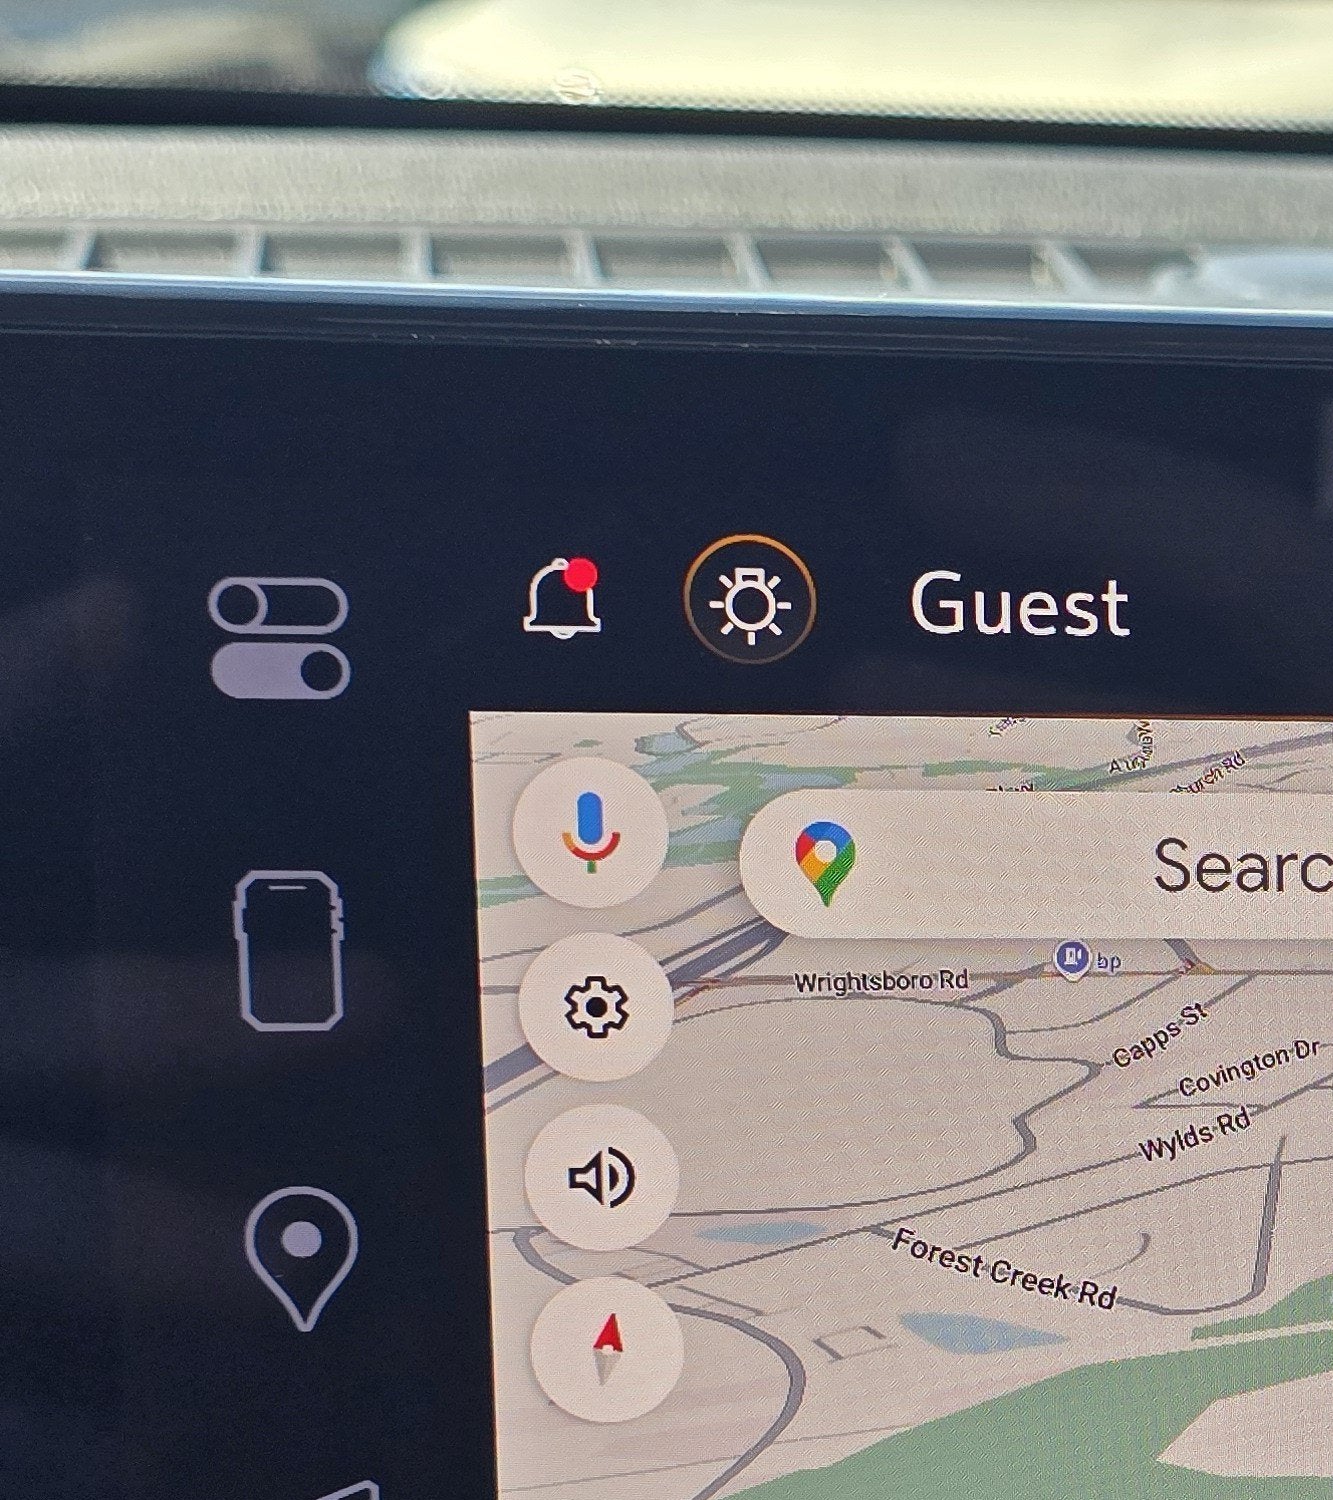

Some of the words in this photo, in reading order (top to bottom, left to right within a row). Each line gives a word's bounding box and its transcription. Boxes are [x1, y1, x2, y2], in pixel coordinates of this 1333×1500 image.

[911, 570, 1131, 636] Guest
[795, 972, 932, 996] Wrightsboro
[939, 969, 968, 989] Rd
[1097, 952, 1121, 972] bp
[1112, 1020, 1181, 1068] Capps
[1180, 1002, 1208, 1026] St
[1179, 1046, 1290, 1098] Covington
[1294, 1039, 1321, 1059] Dr
[1138, 1126, 1215, 1162] Wylds
[1217, 1108, 1251, 1136] Rd
[891, 1227, 983, 1278] Forest
[989, 1258, 1072, 1301] Creek
[1078, 1280, 1118, 1311] Rd
